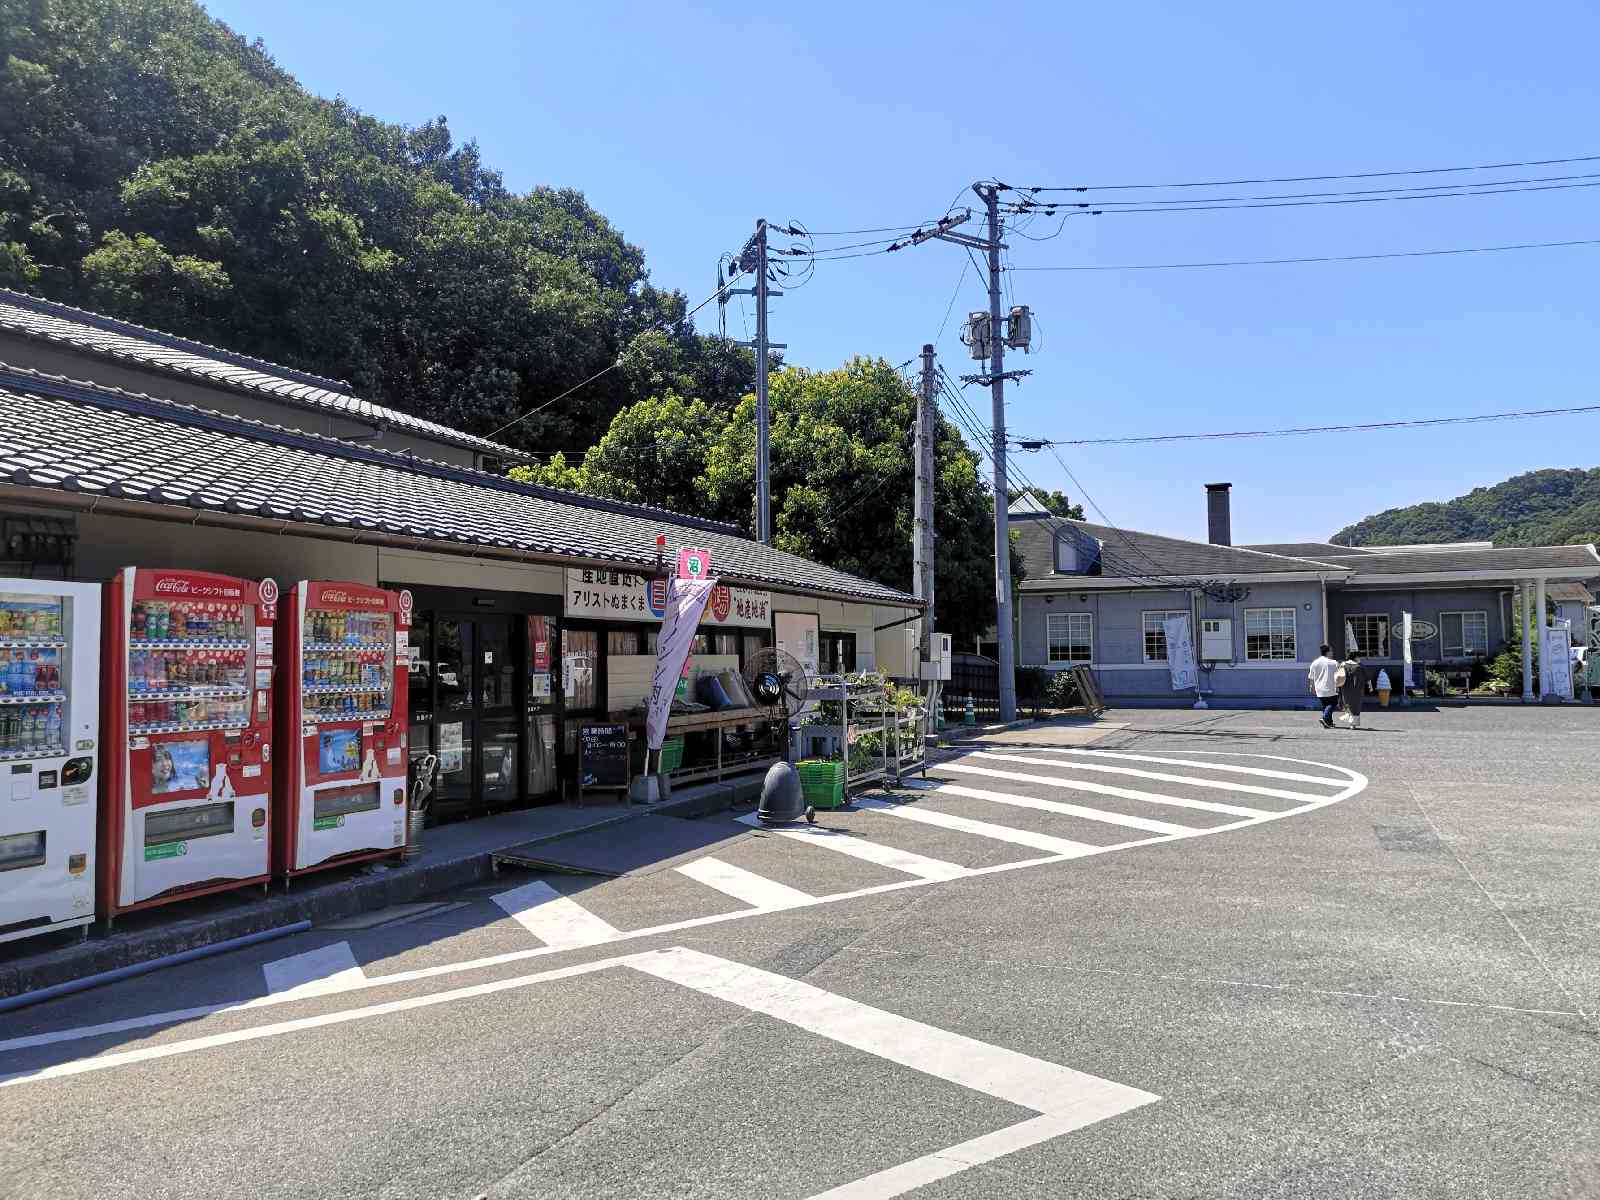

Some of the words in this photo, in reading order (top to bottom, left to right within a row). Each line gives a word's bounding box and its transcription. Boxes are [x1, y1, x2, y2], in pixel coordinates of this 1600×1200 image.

[573, 590, 645, 612] アリストぬまくま
